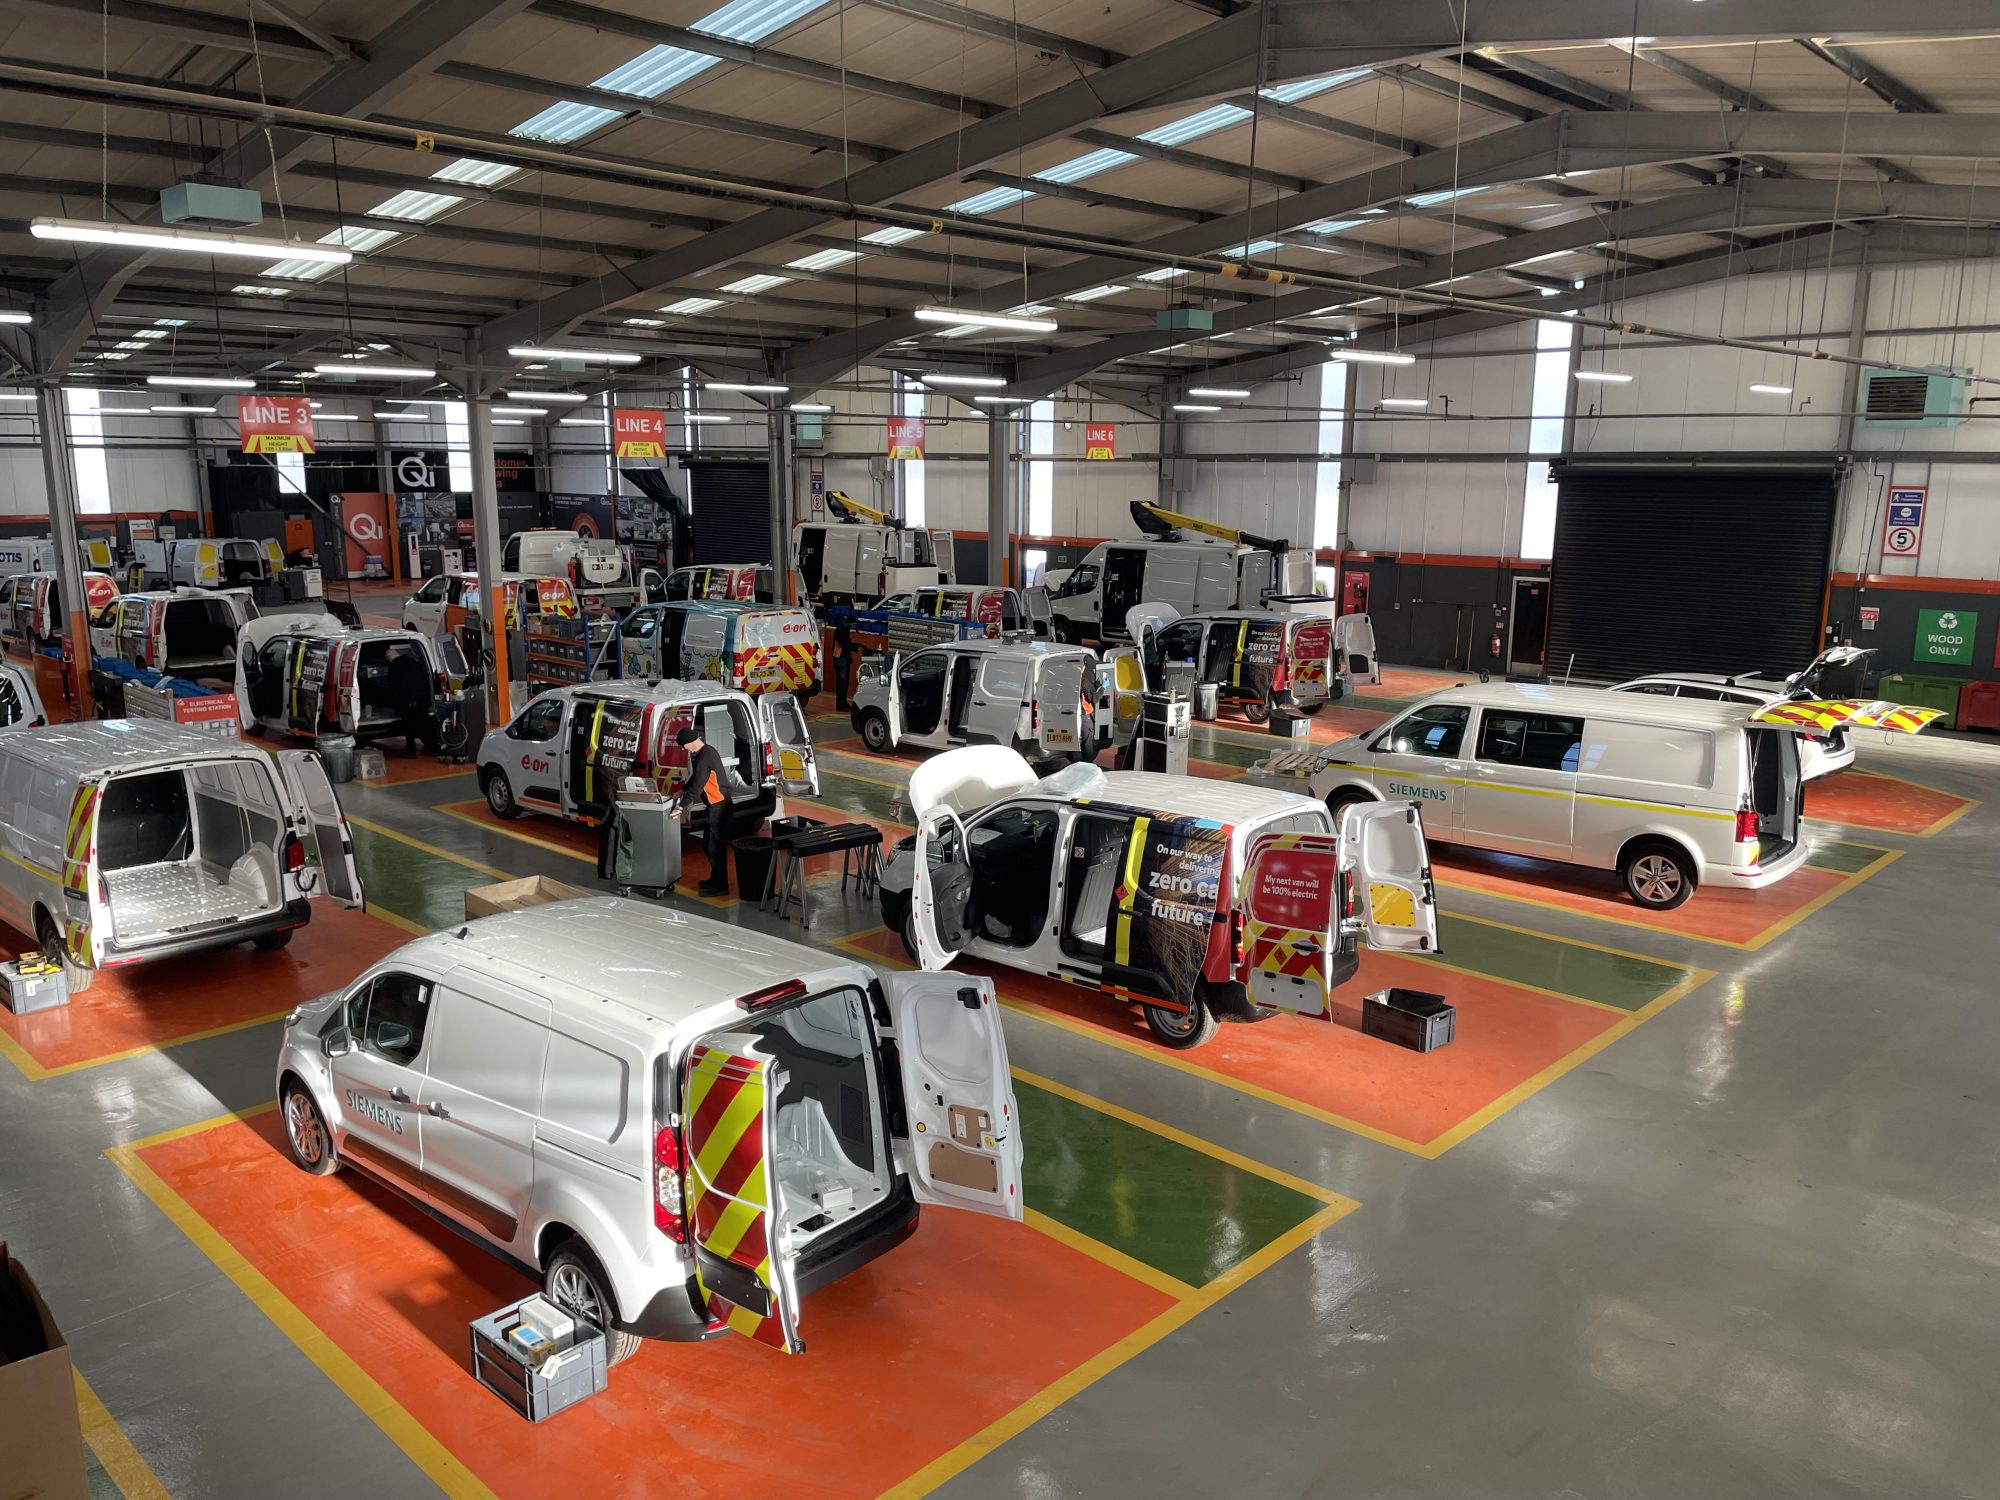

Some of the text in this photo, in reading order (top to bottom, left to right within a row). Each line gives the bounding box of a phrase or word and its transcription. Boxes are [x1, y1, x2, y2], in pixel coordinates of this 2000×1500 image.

[242, 406, 309, 424] LINE 3
[616, 418, 663, 433] LINE 4
[889, 425, 923, 439] LINE 5
[1087, 430, 1114, 441] LINE 6
[397, 456, 436, 488] Qi
[496, 469, 518, 480] wing
[349, 512, 384, 540] Qi
[1896, 532, 1908, 545] 5
[0, 552, 23, 564] OTIS
[942, 609, 957, 617] zero
[1927, 633, 1964, 645] WOOD
[1248, 642, 1269, 652] zero
[1928, 645, 1960, 656] ONLY
[1249, 654, 1274, 664] future
[189, 699, 224, 707] ELECTRICAL
[602, 735, 625, 749] zero
[601, 754, 628, 770] future
[1389, 783, 1447, 801] SIEMENS
[1157, 843, 1213, 862] On our way to
[1179, 860, 1220, 878] delivering
[1149, 871, 1192, 894] zero
[1264, 874, 1320, 889] My next van will
[1262, 884, 1318, 900] be 100% electric
[1151, 899, 1204, 927] future
[346, 1088, 403, 1135] SIEMENS
